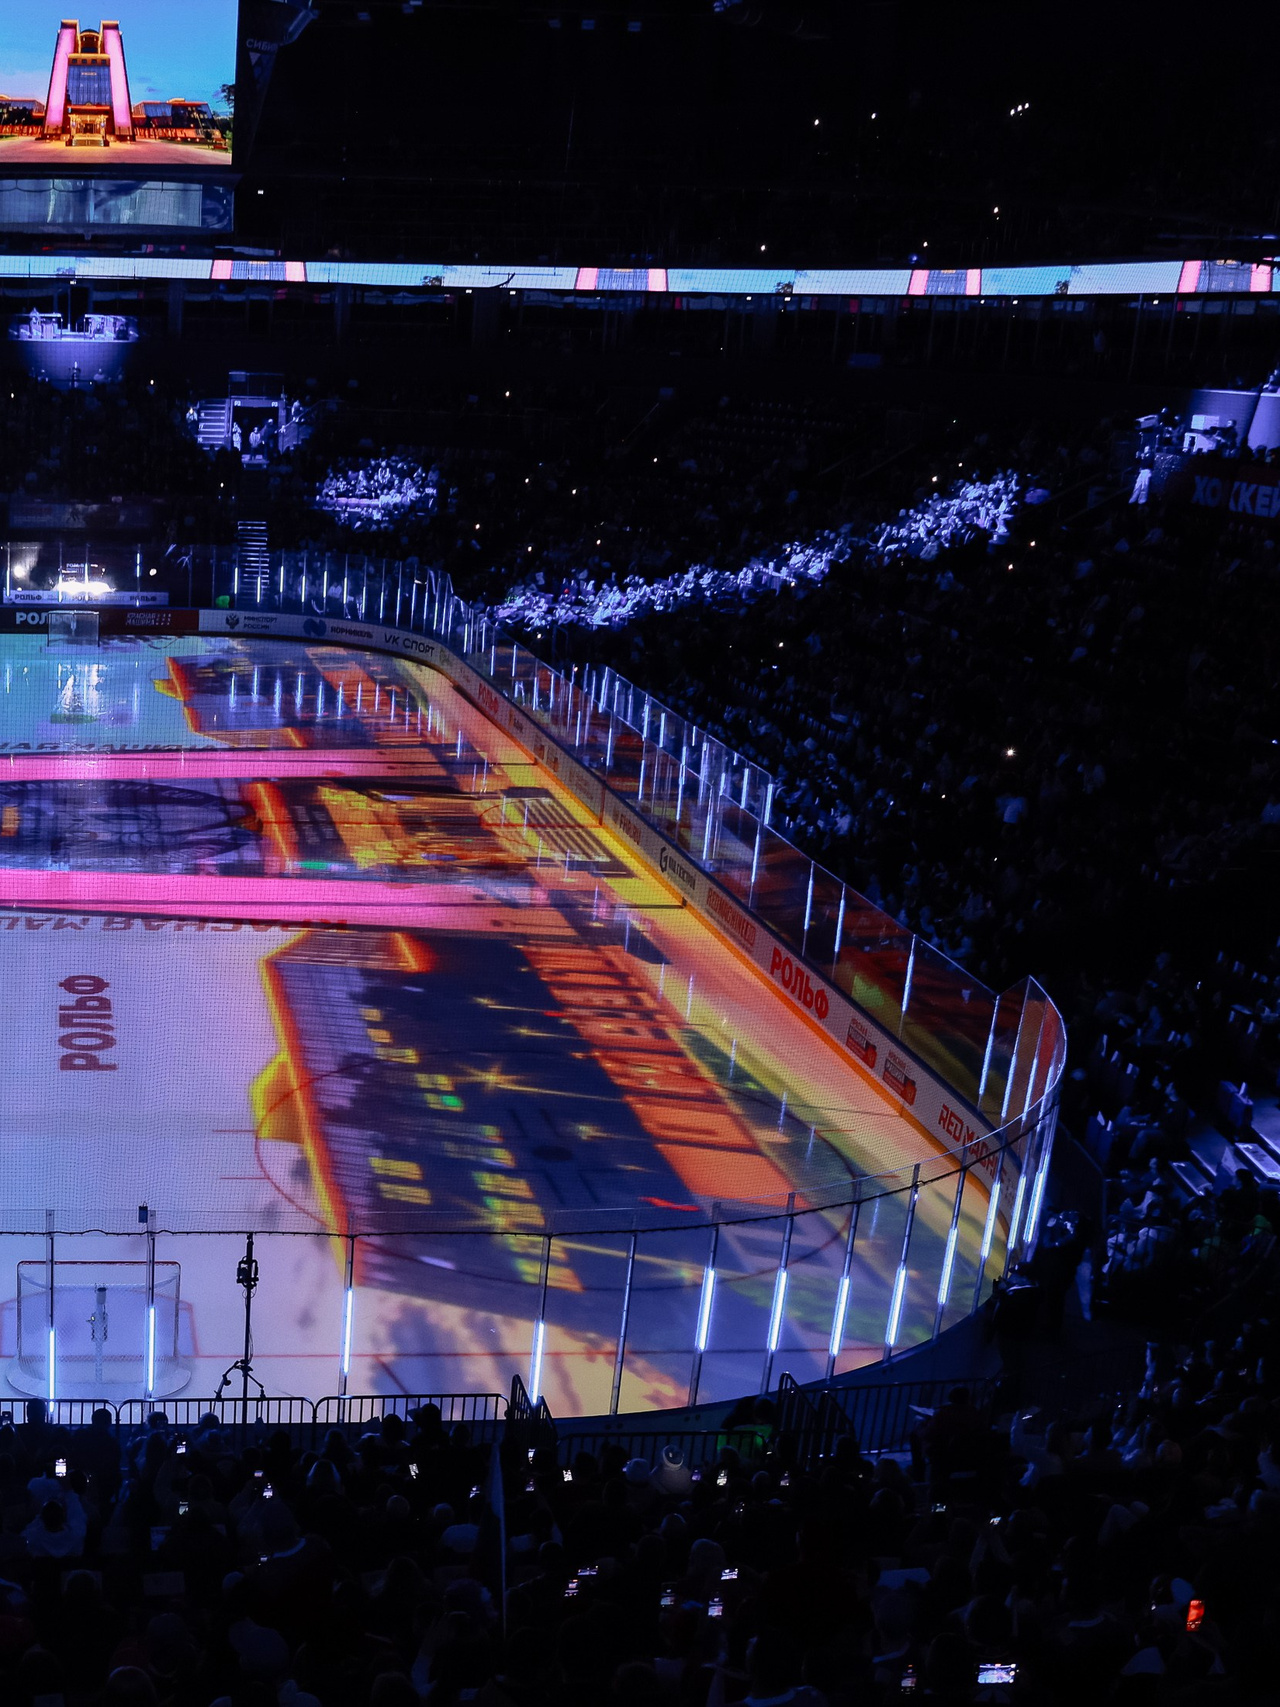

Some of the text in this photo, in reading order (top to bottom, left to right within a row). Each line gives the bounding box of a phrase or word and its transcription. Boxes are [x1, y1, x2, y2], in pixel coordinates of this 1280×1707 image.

[243, 615, 278, 623] МИНСПОРТ
[330, 625, 373, 639] НОРНИКЕЛЬ
[384, 632, 401, 645] VK
[402, 637, 435, 657] СПОРТ
[770, 947, 829, 1019] РОЛЬФ
[58, 975, 118, 1071] РОЛЬФ
[938, 1103, 964, 1143] RED
